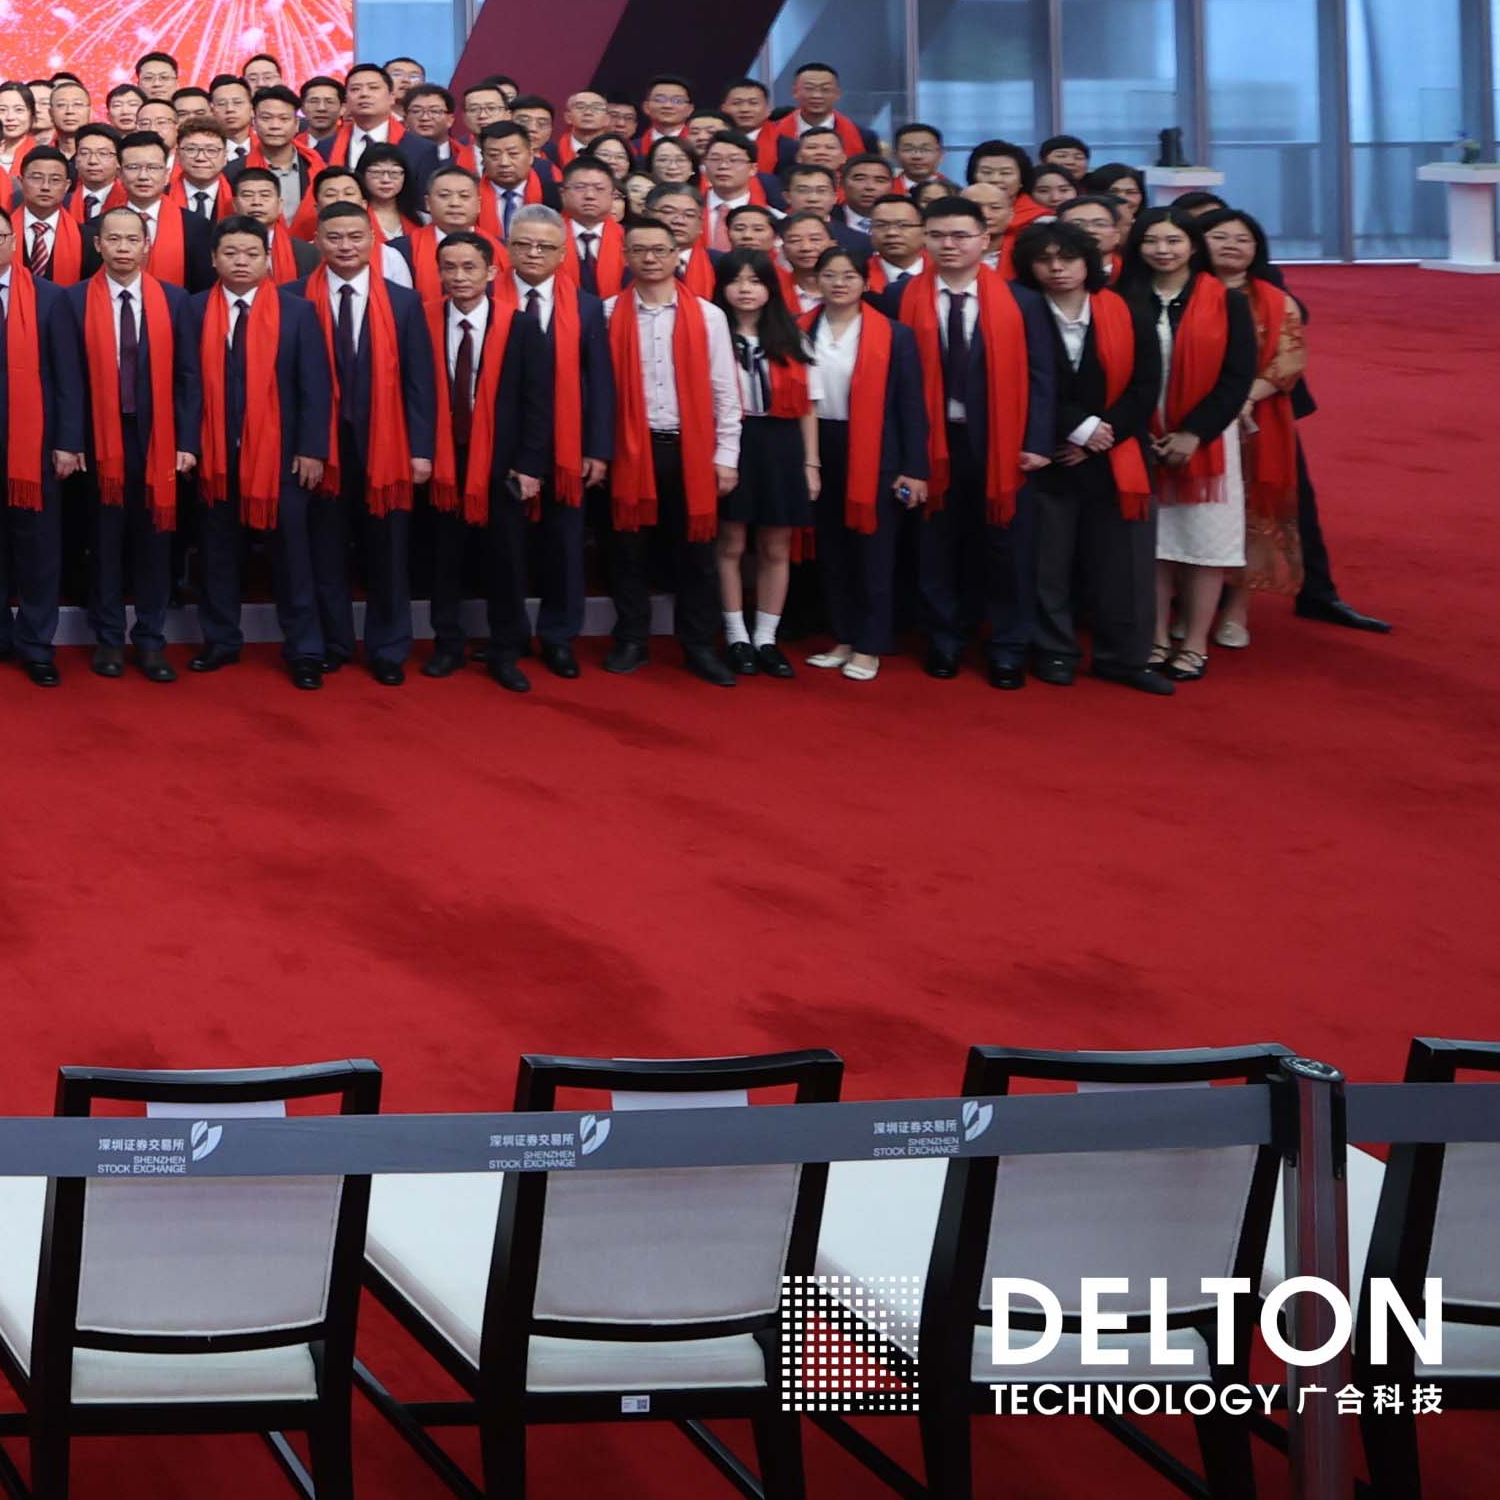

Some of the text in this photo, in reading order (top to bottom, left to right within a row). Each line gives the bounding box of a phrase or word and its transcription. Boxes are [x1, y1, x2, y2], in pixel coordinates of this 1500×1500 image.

[98, 1139, 185, 1151] 深圳证券交易所
[908, 1137, 959, 1146] SHENZHEN
[524, 1150, 575, 1159] SHENZHEN
[873, 1145, 960, 1157] STOCK EXCHANGE
[133, 1155, 186, 1164] SHENZHEN
[489, 1159, 576, 1169] STOCK EXCHANGE
[98, 1164, 186, 1173] STOCK EXCHANGE
